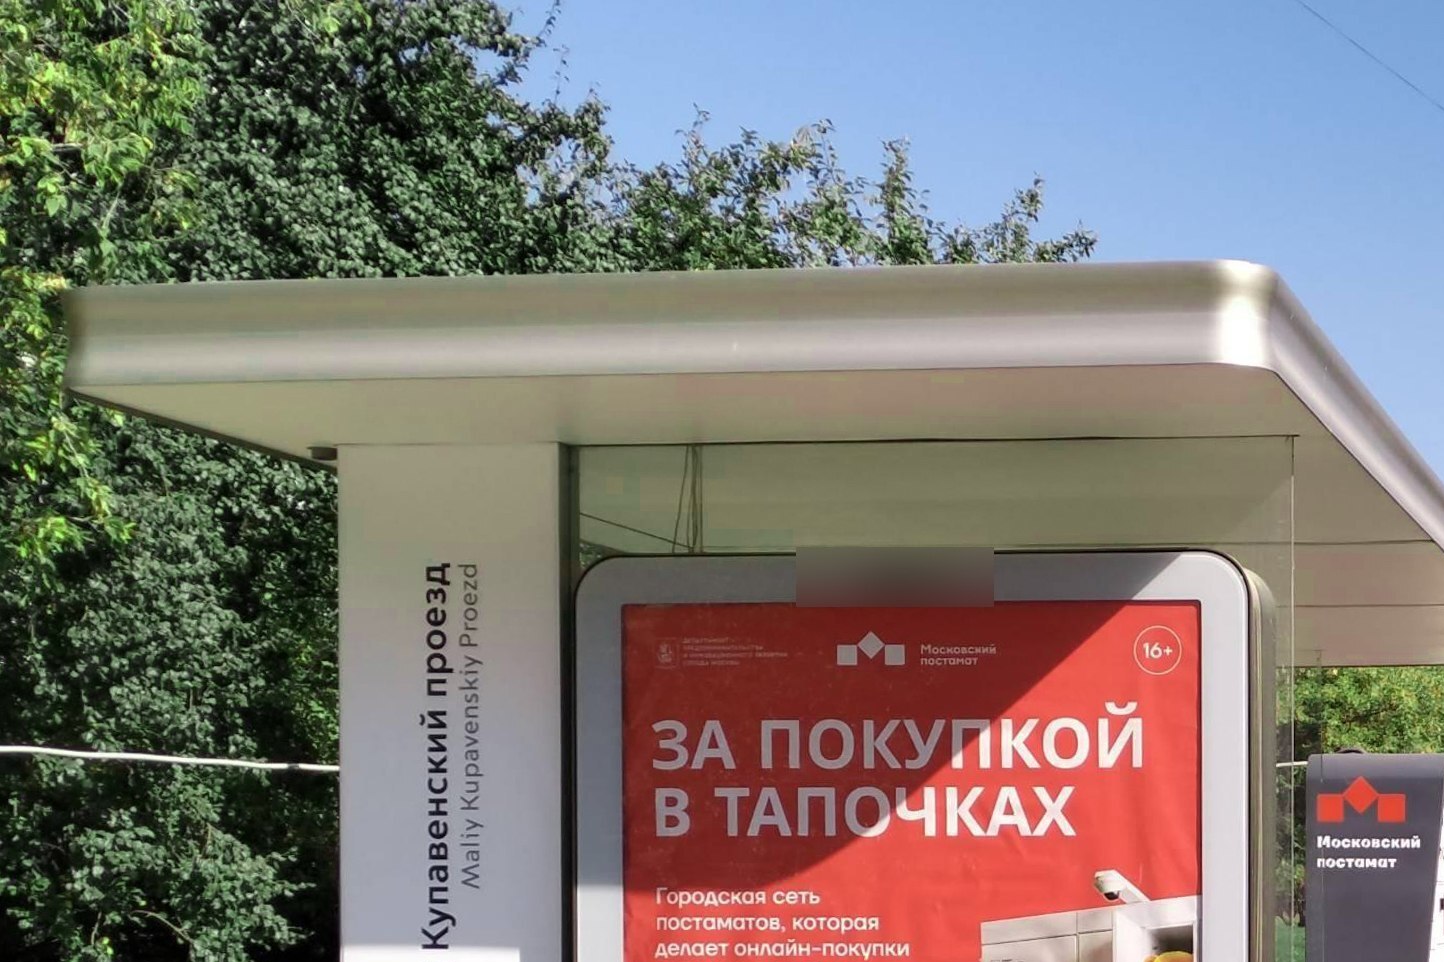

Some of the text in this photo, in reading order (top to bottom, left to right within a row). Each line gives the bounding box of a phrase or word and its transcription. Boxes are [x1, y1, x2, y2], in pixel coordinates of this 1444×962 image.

[425, 562, 454, 697] проезд
[920, 643, 997, 656] Московский
[1142, 642, 1173, 659] 16+
[920, 656, 978, 666] постамат
[457, 564, 484, 889] Maliy Kupavenskiy Proezd
[652, 701, 1144, 770] ЗА ПОКУПКОЙ
[655, 786, 1077, 837] В ТАПОЧКАХ
[419, 710, 456, 950] Купавенский
[1316, 835, 1421, 849] Московский
[1316, 858, 1397, 869] постамат
[656, 888, 821, 908] Городская сеть
[656, 916, 880, 934] постаматов, которая
[655, 939, 910, 961] делает онлайн-покупки
